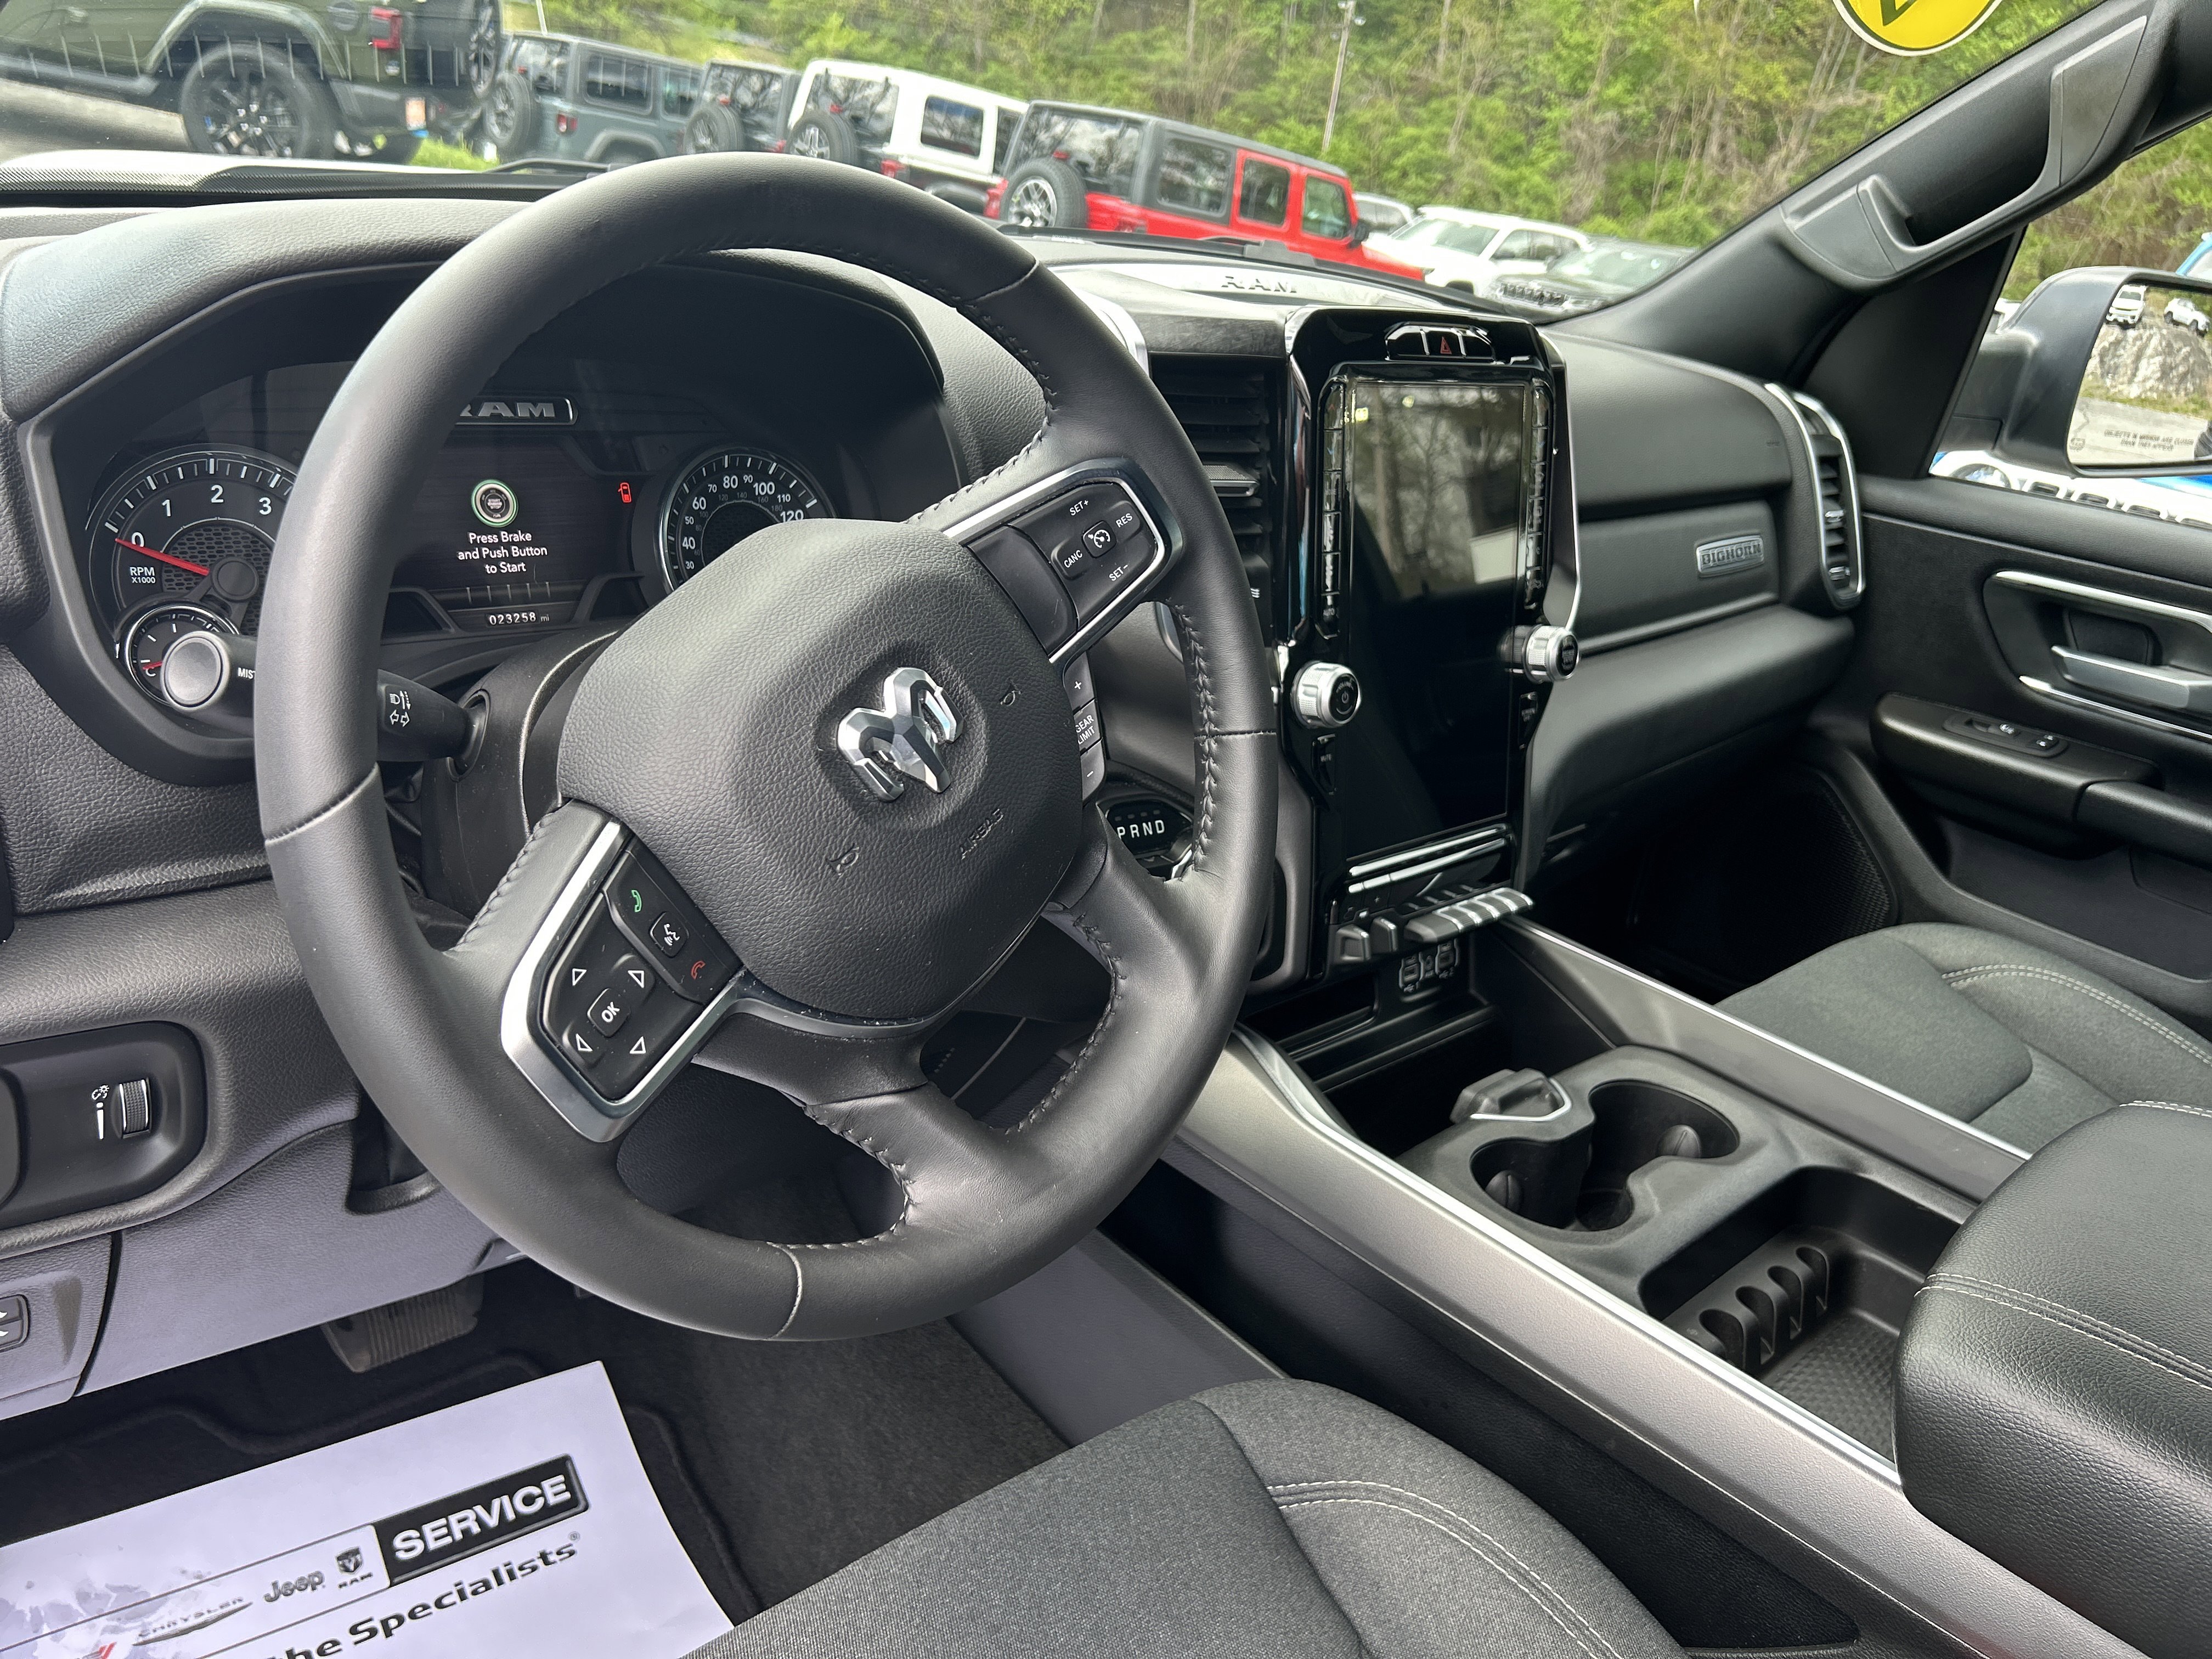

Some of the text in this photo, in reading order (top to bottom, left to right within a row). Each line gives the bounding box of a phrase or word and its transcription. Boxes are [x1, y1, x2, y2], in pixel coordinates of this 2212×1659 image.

[723, 476, 738, 488] 80
[743, 475, 753, 483] 90
[211, 485, 224, 503] 2
[708, 484, 717, 493] 70
[753, 482, 775, 495] 100
[258, 497, 272, 515] 3
[692, 497, 707, 510] 60
[777, 494, 791, 503] 110
[162, 499, 171, 516] 1
[780, 509, 804, 522] 120
[1116, 513, 1133, 528] RES
[131, 532, 144, 548] 0
[469, 530, 532, 544] Press Brake
[682, 537, 696, 549] 40
[458, 545, 548, 560] and Push Button
[1064, 550, 1083, 568] CANC
[129, 567, 155, 576] RPM
[485, 561, 527, 574] to Start
[685, 561, 695, 569] 30
[489, 612, 549, 625] 023258 mi
[1075, 715, 1094, 733] GEAR
[1077, 725, 1095, 744] LIMIT
[601, 1001, 620, 1023] OK
[392, 1474, 572, 1560] SERVICE
[264, 1570, 325, 1603] Jeep
[338, 1572, 373, 1589] RAM
[267, 1638, 342, 1659] he
